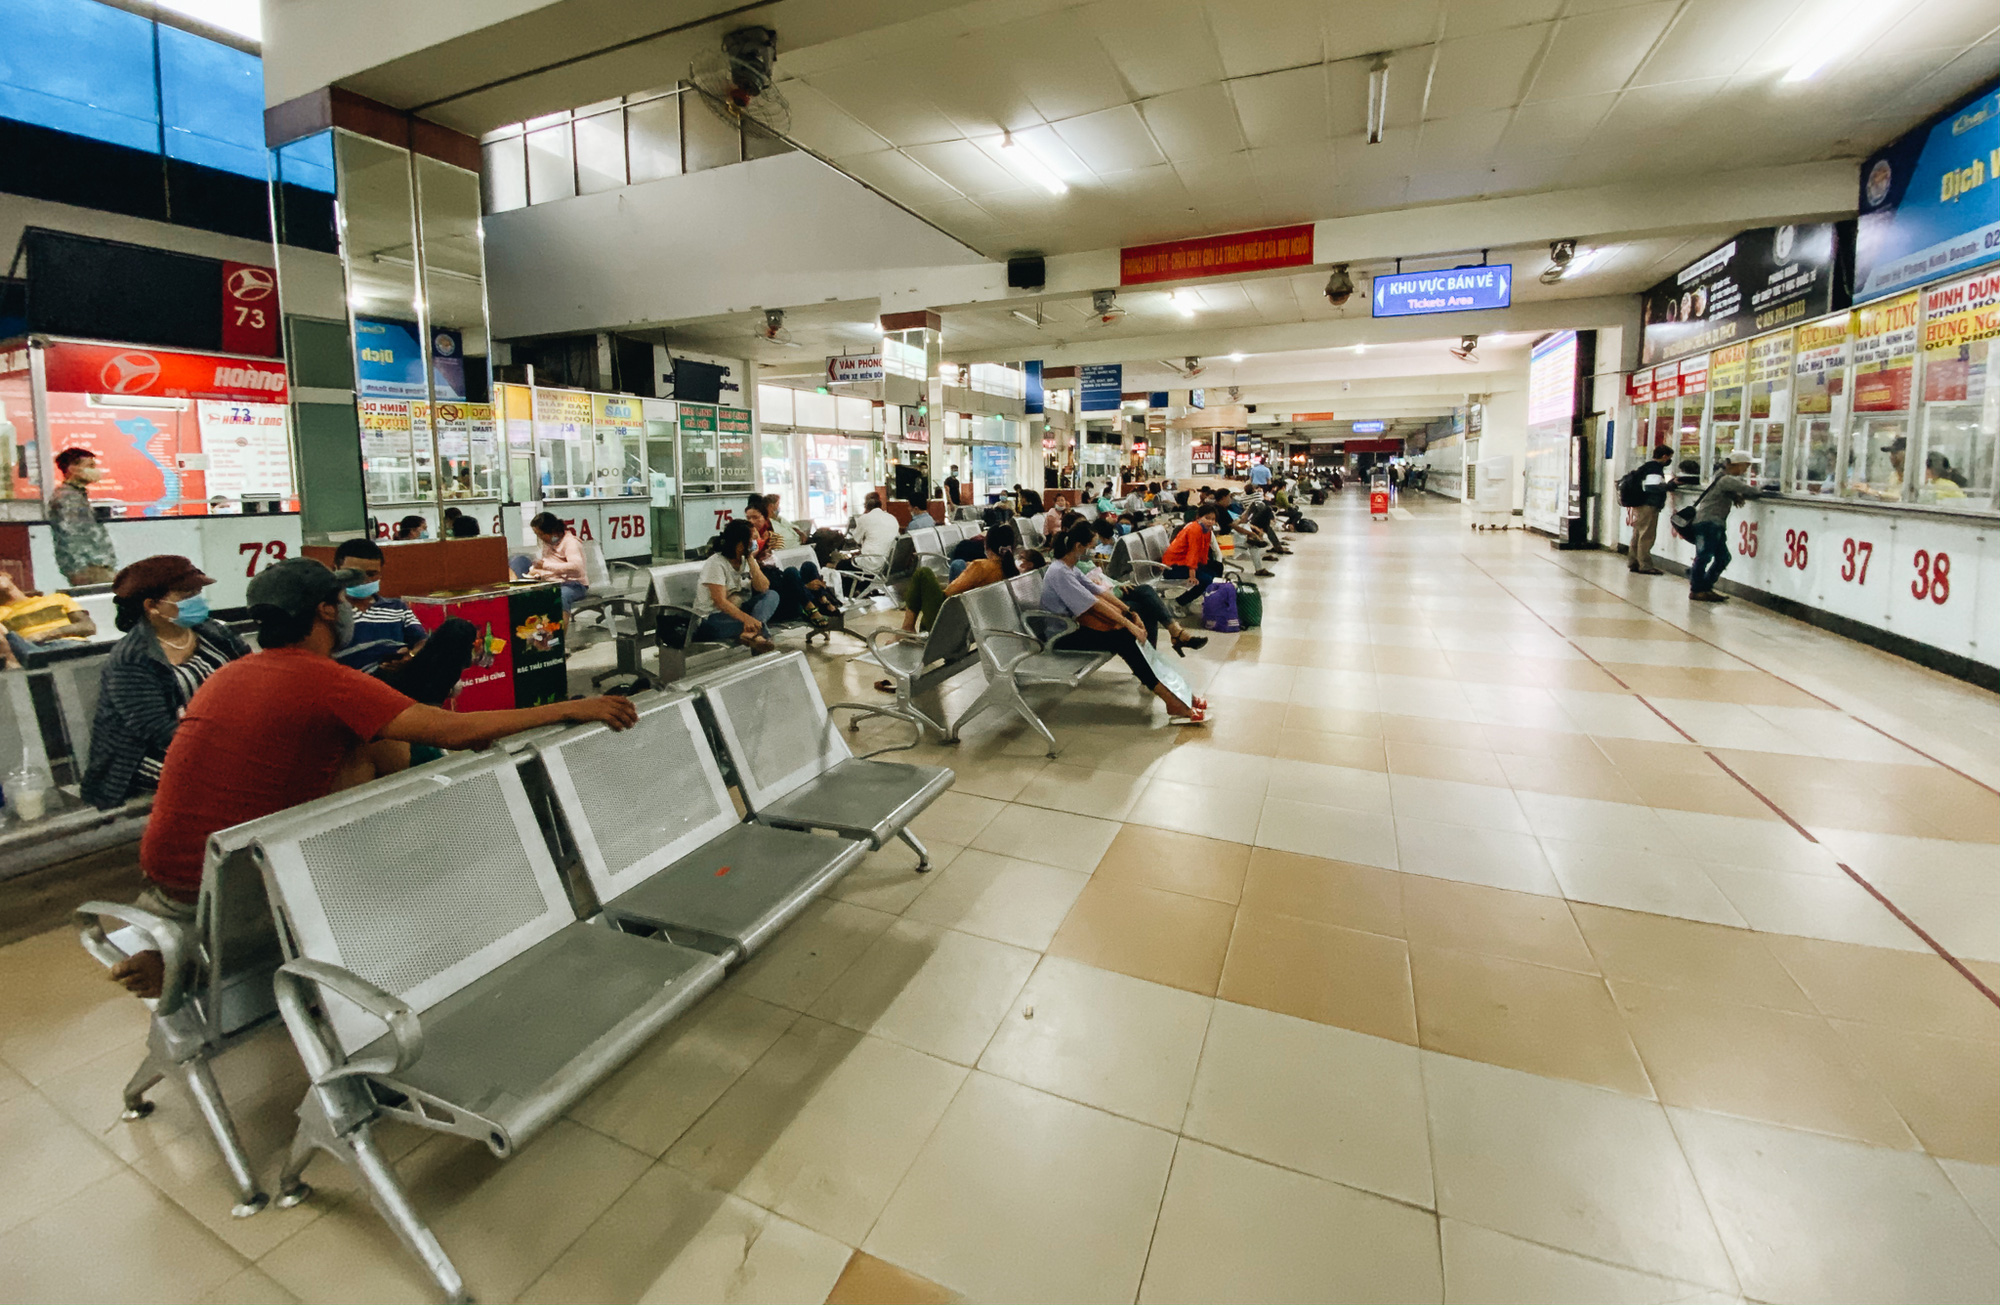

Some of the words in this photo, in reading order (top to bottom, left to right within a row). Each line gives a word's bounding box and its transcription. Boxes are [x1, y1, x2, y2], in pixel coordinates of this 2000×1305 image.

[1941, 158, 1985, 202] Dịch
[1390, 280, 1416, 295] KHU
[1419, 277, 1445, 295] VỰC
[1447, 274, 1475, 290] BÁN
[1477, 271, 1494, 287] VÉ
[1407, 298, 1445, 309] Tickets
[1447, 296, 1474, 306] Area
[1928, 286, 1964, 312] MINH
[234, 306, 266, 329] 73
[1928, 304, 1968, 321] NINH
[1974, 311, 2000, 331] NG
[213, 363, 286, 392] HOÀNG
[231, 407, 252, 422] 73
[258, 416, 283, 427] LONG
[605, 404, 632, 419] SAO
[564, 518, 594, 541] 5A
[608, 515, 646, 540] 75B
[1739, 520, 1758, 558] 35
[239, 540, 288, 577] 73
[1784, 528, 1809, 571] 36
[1842, 537, 1873, 586] 37
[1911, 549, 1951, 605] 38
